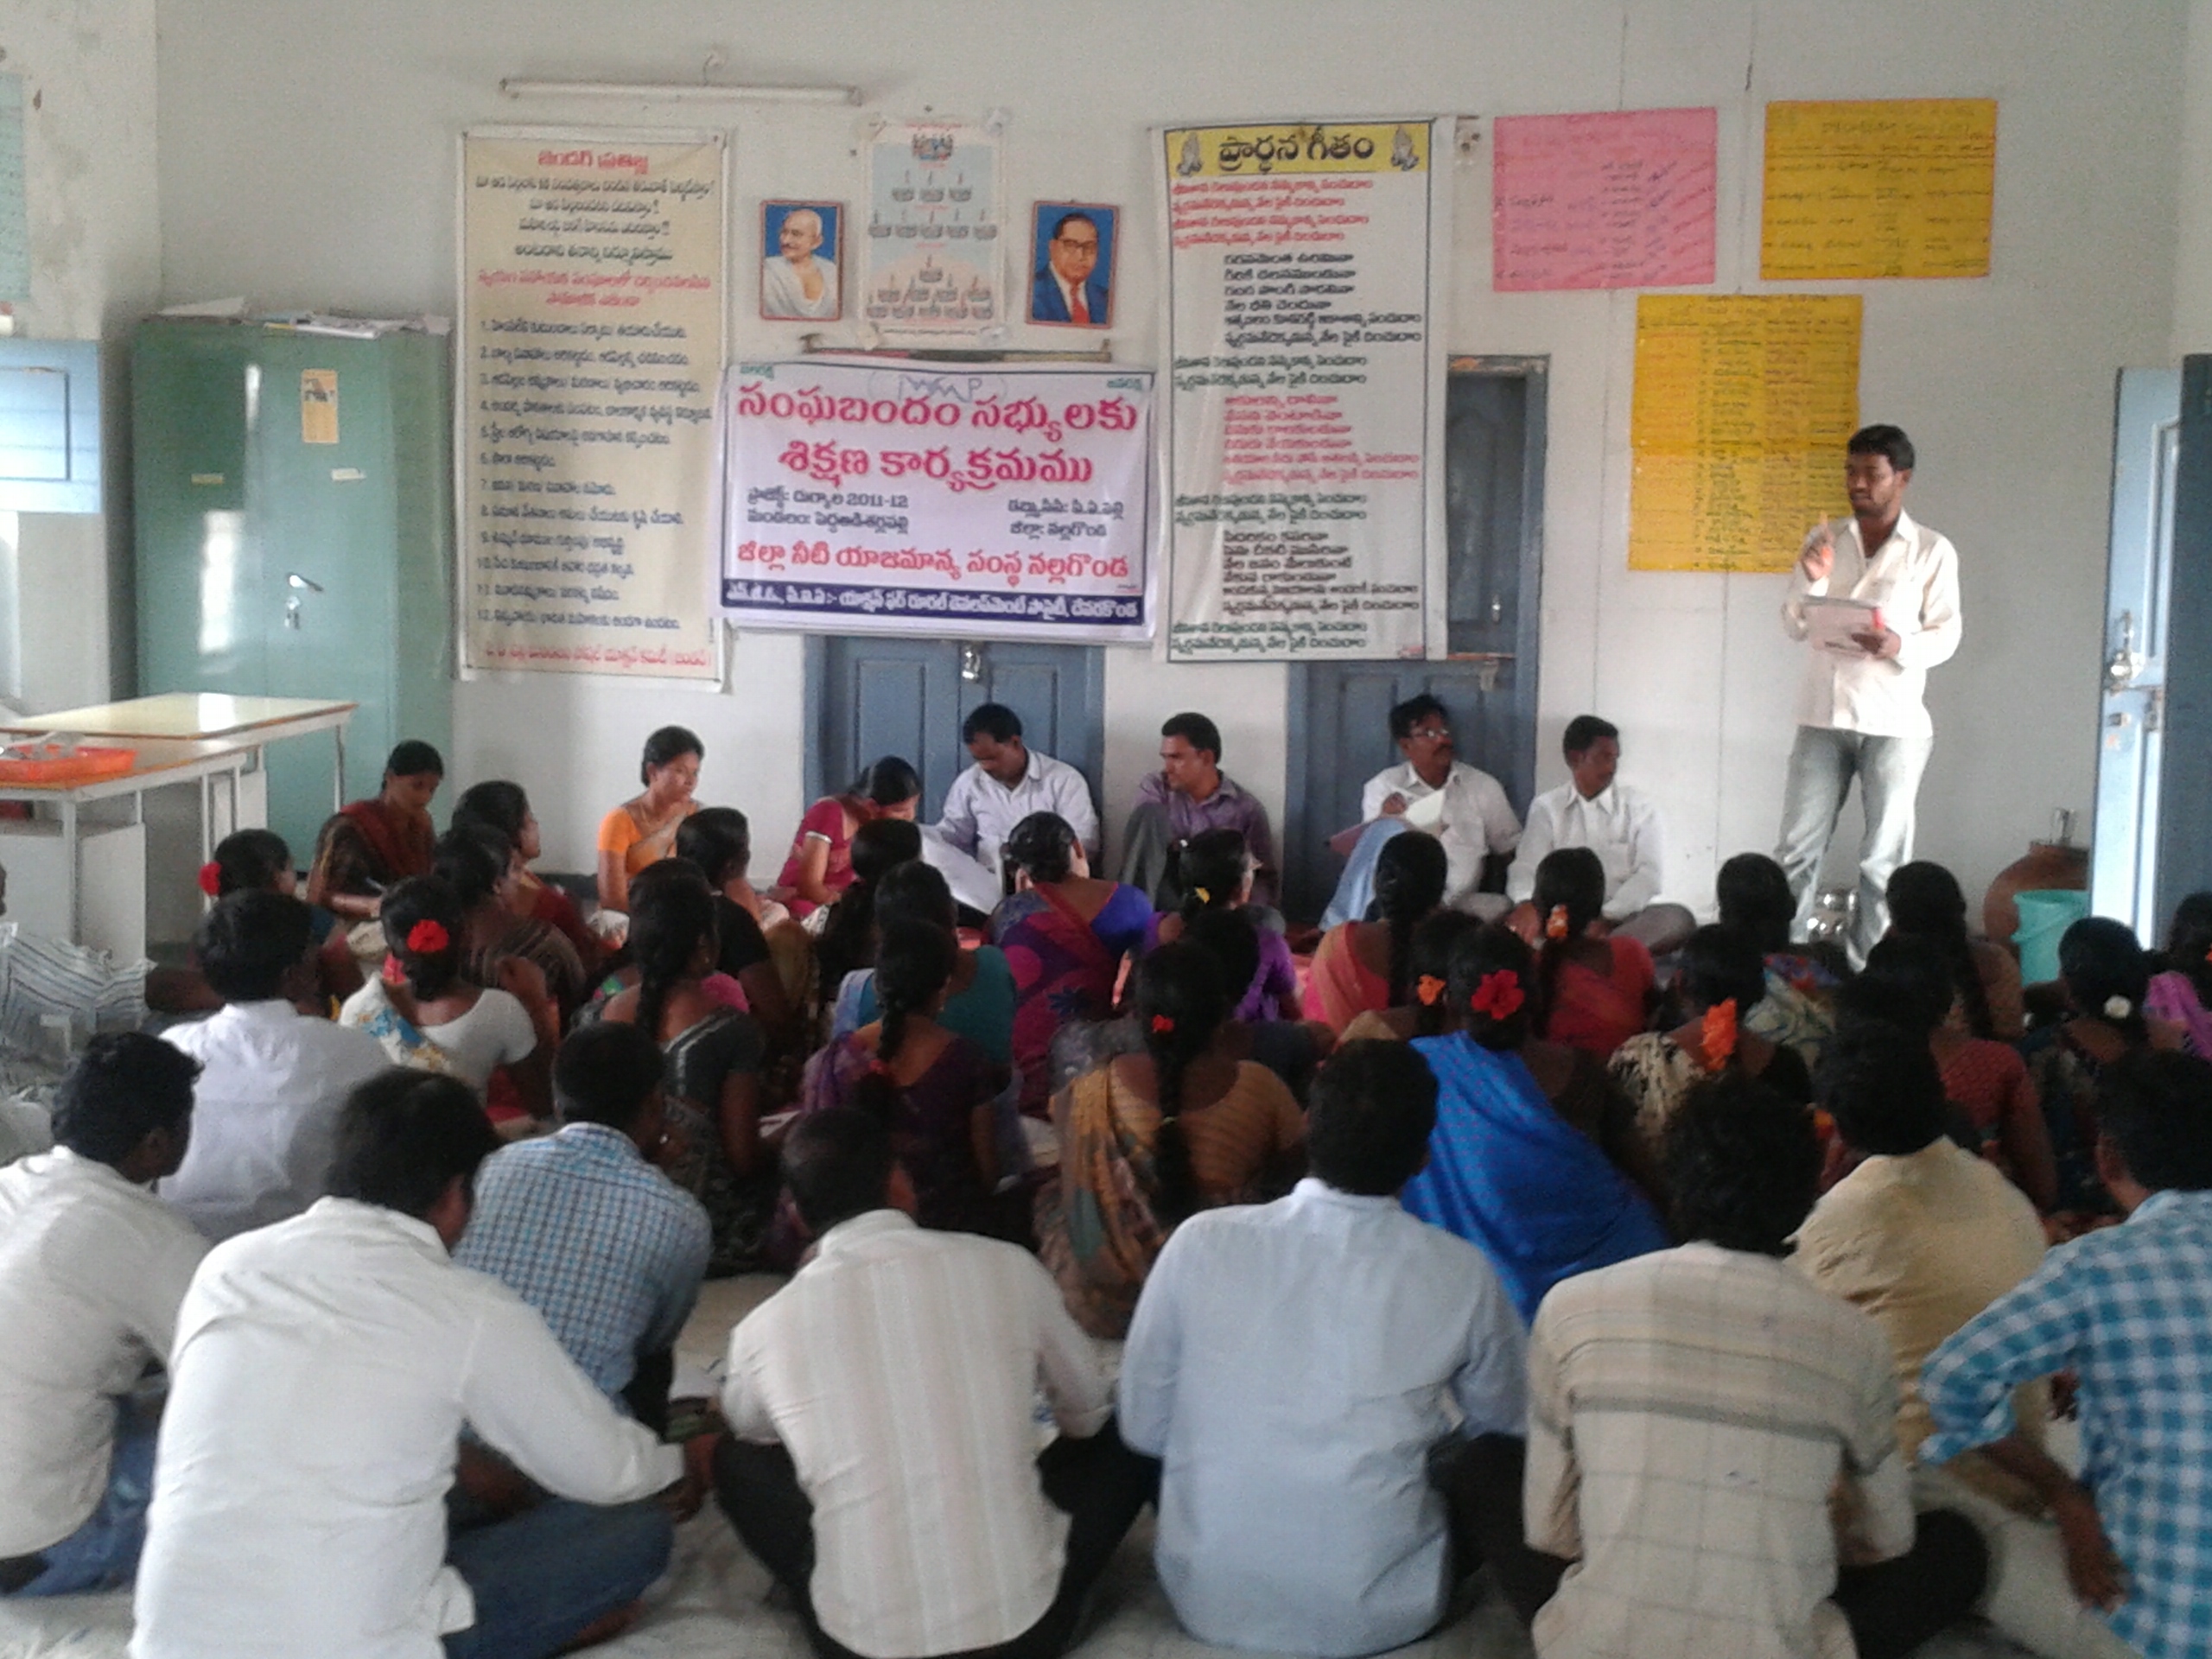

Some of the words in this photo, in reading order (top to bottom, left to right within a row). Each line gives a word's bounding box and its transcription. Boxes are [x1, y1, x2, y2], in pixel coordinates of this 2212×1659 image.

[1306, 125, 1375, 160] గీతం
[971, 394, 1138, 442] సభ్యులకు
[778, 439, 869, 487] శిక్షణ
[880, 445, 1093, 492] కార్యక్రమము
[846, 493, 909, 508] 2011-12
[737, 540, 786, 571] జిల్లా
[791, 540, 830, 565] నీటి
[836, 544, 961, 581] యాజమాన్య
[967, 549, 1023, 587] సంస్థ
[1028, 551, 1129, 584] నల్లగొండ
